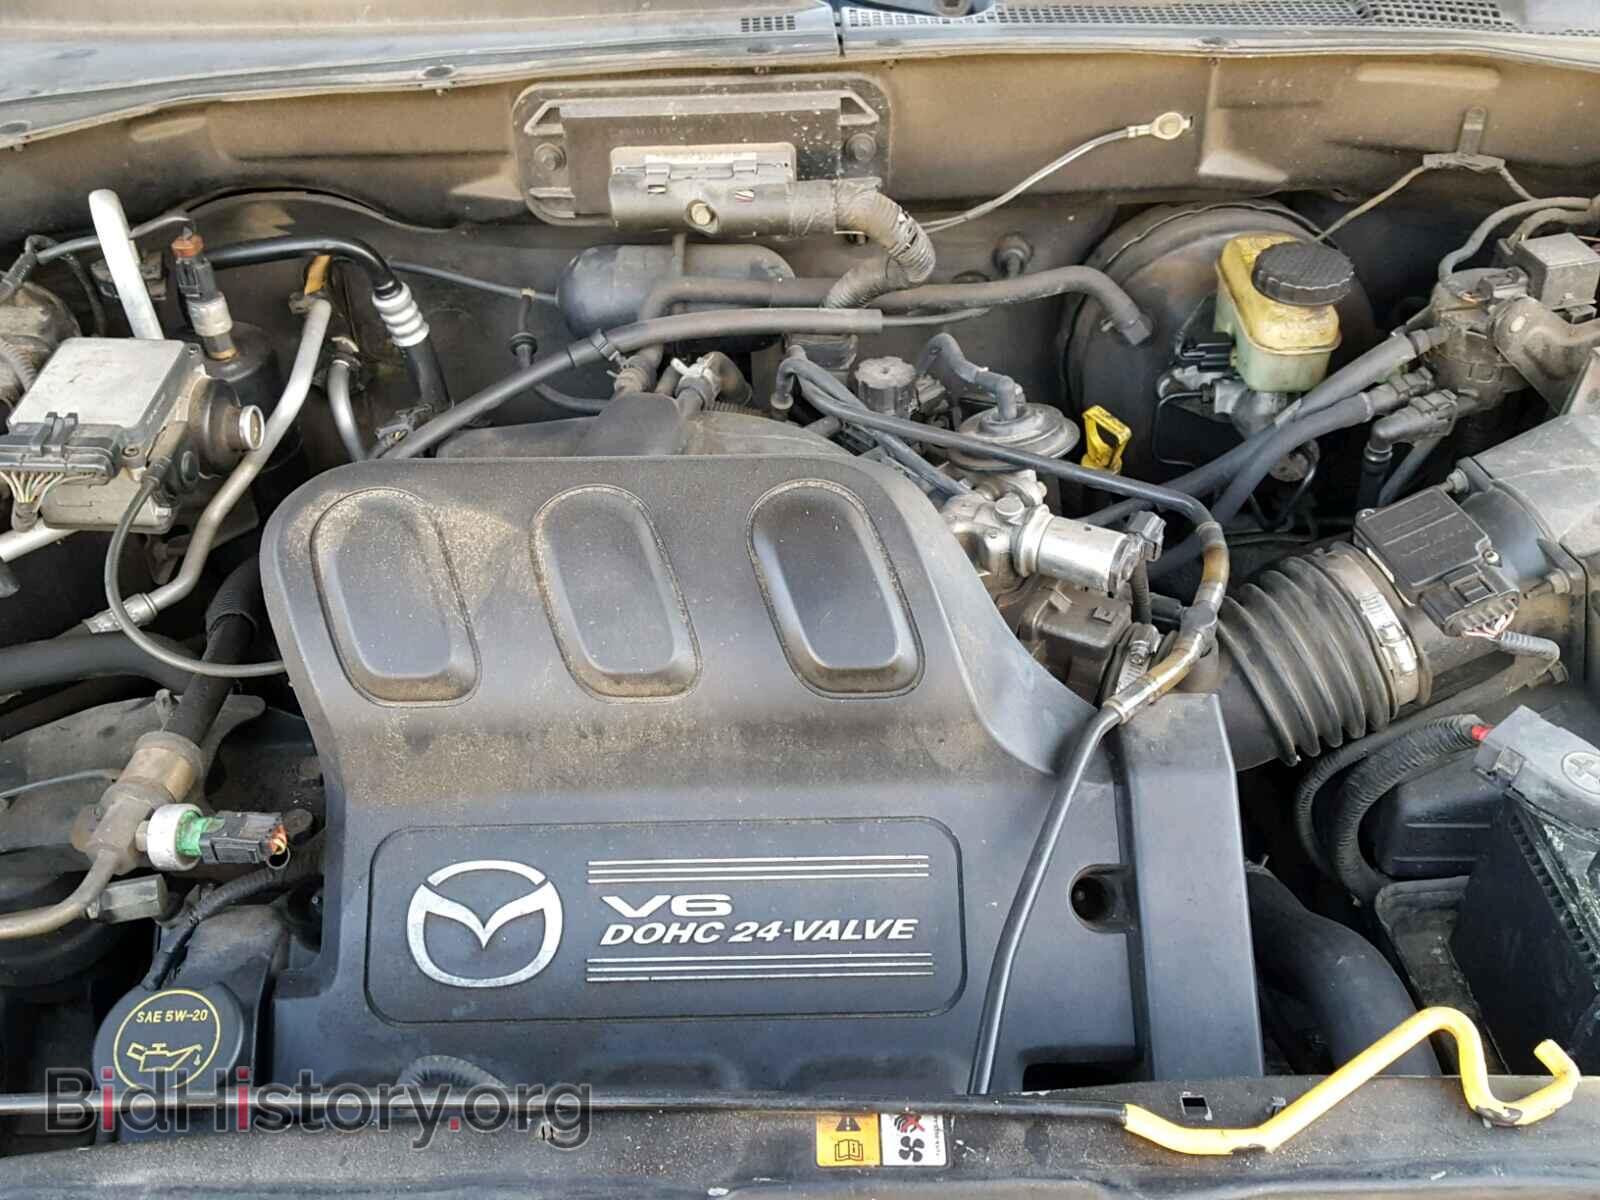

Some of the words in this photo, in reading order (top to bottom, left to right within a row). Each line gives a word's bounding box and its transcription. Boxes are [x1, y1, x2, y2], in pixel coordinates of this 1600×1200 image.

[601, 894, 733, 918] V6
[599, 921, 726, 946] DOHC
[727, 918, 919, 943] 24-VALVE
[136, 1010, 163, 1024] SAE
[165, 1009, 209, 1023] 5W-20
